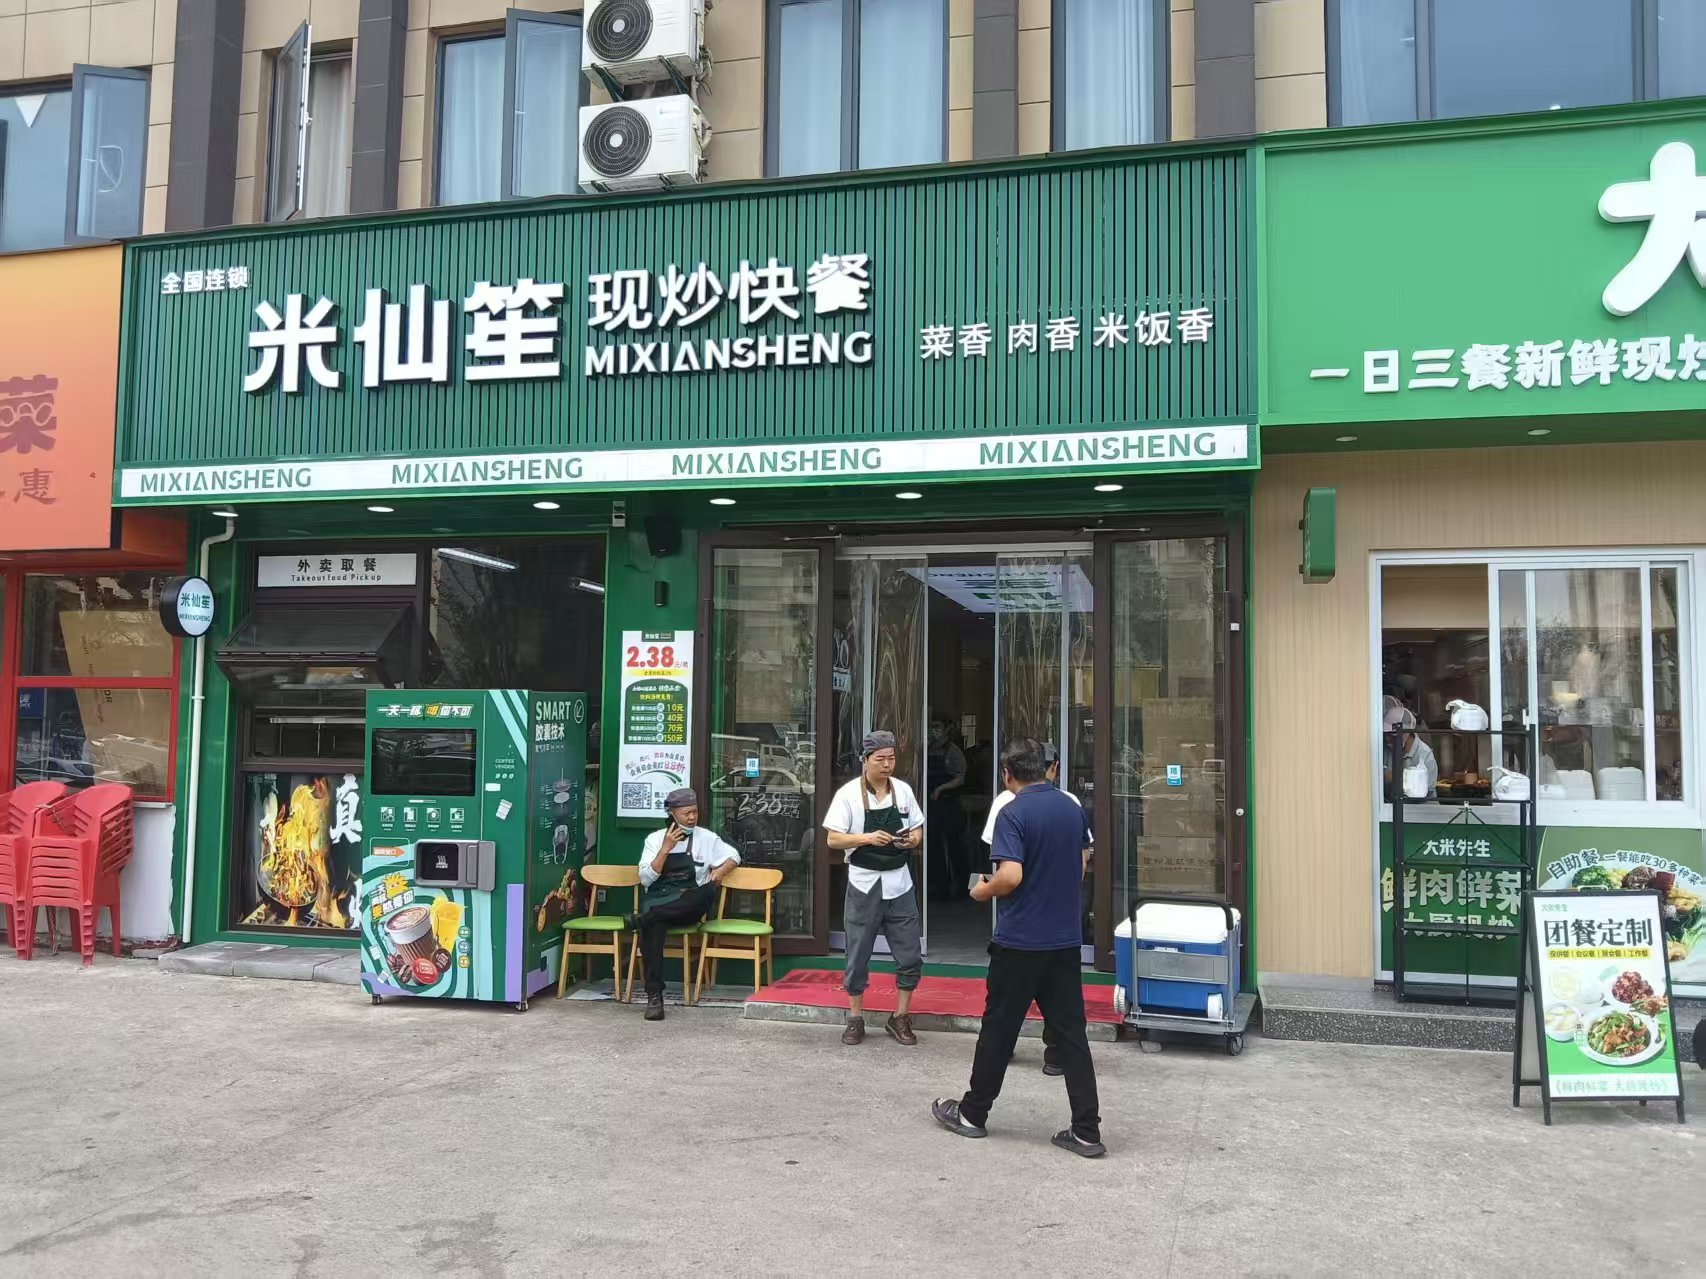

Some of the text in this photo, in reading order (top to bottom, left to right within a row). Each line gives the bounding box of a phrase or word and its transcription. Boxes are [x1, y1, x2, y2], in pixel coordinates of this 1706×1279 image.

[160, 265, 250, 296] 全国连锁
[586, 252, 870, 332] 现炒快餐
[243, 277, 564, 394] 米仙笙
[919, 305, 1214, 361] 菜香 肉香 米饭香
[585, 331, 873, 377] MIXIANSHENG
[671, 443, 883, 478] MIXIANSHENG
[979, 428, 1217, 469] MIXIANSHENG
[139, 466, 313, 494] MIXIANSHENG
[391, 457, 585, 486] MIXIANSHENG
[0, 467, 58, 506] 惠
[297, 556, 377, 573] 外卖取餐
[180, 592, 211, 609] 米仙笙
[626, 645, 674, 668] 2.38
[535, 700, 571, 721] SMART
[667, 704, 685, 712] 10元
[667, 714, 685, 722] 40元
[535, 723, 565, 741] 胶囊技术
[667, 724, 685, 732] 70元
[739, 792, 782, 815] 2.38
[1423, 838, 1491, 858] 大米先生
[1547, 848, 1601, 880] 自助餐
[1381, 867, 1531, 915] 鲜肉鲜菜
[1543, 918, 1654, 947] 团餐定制
